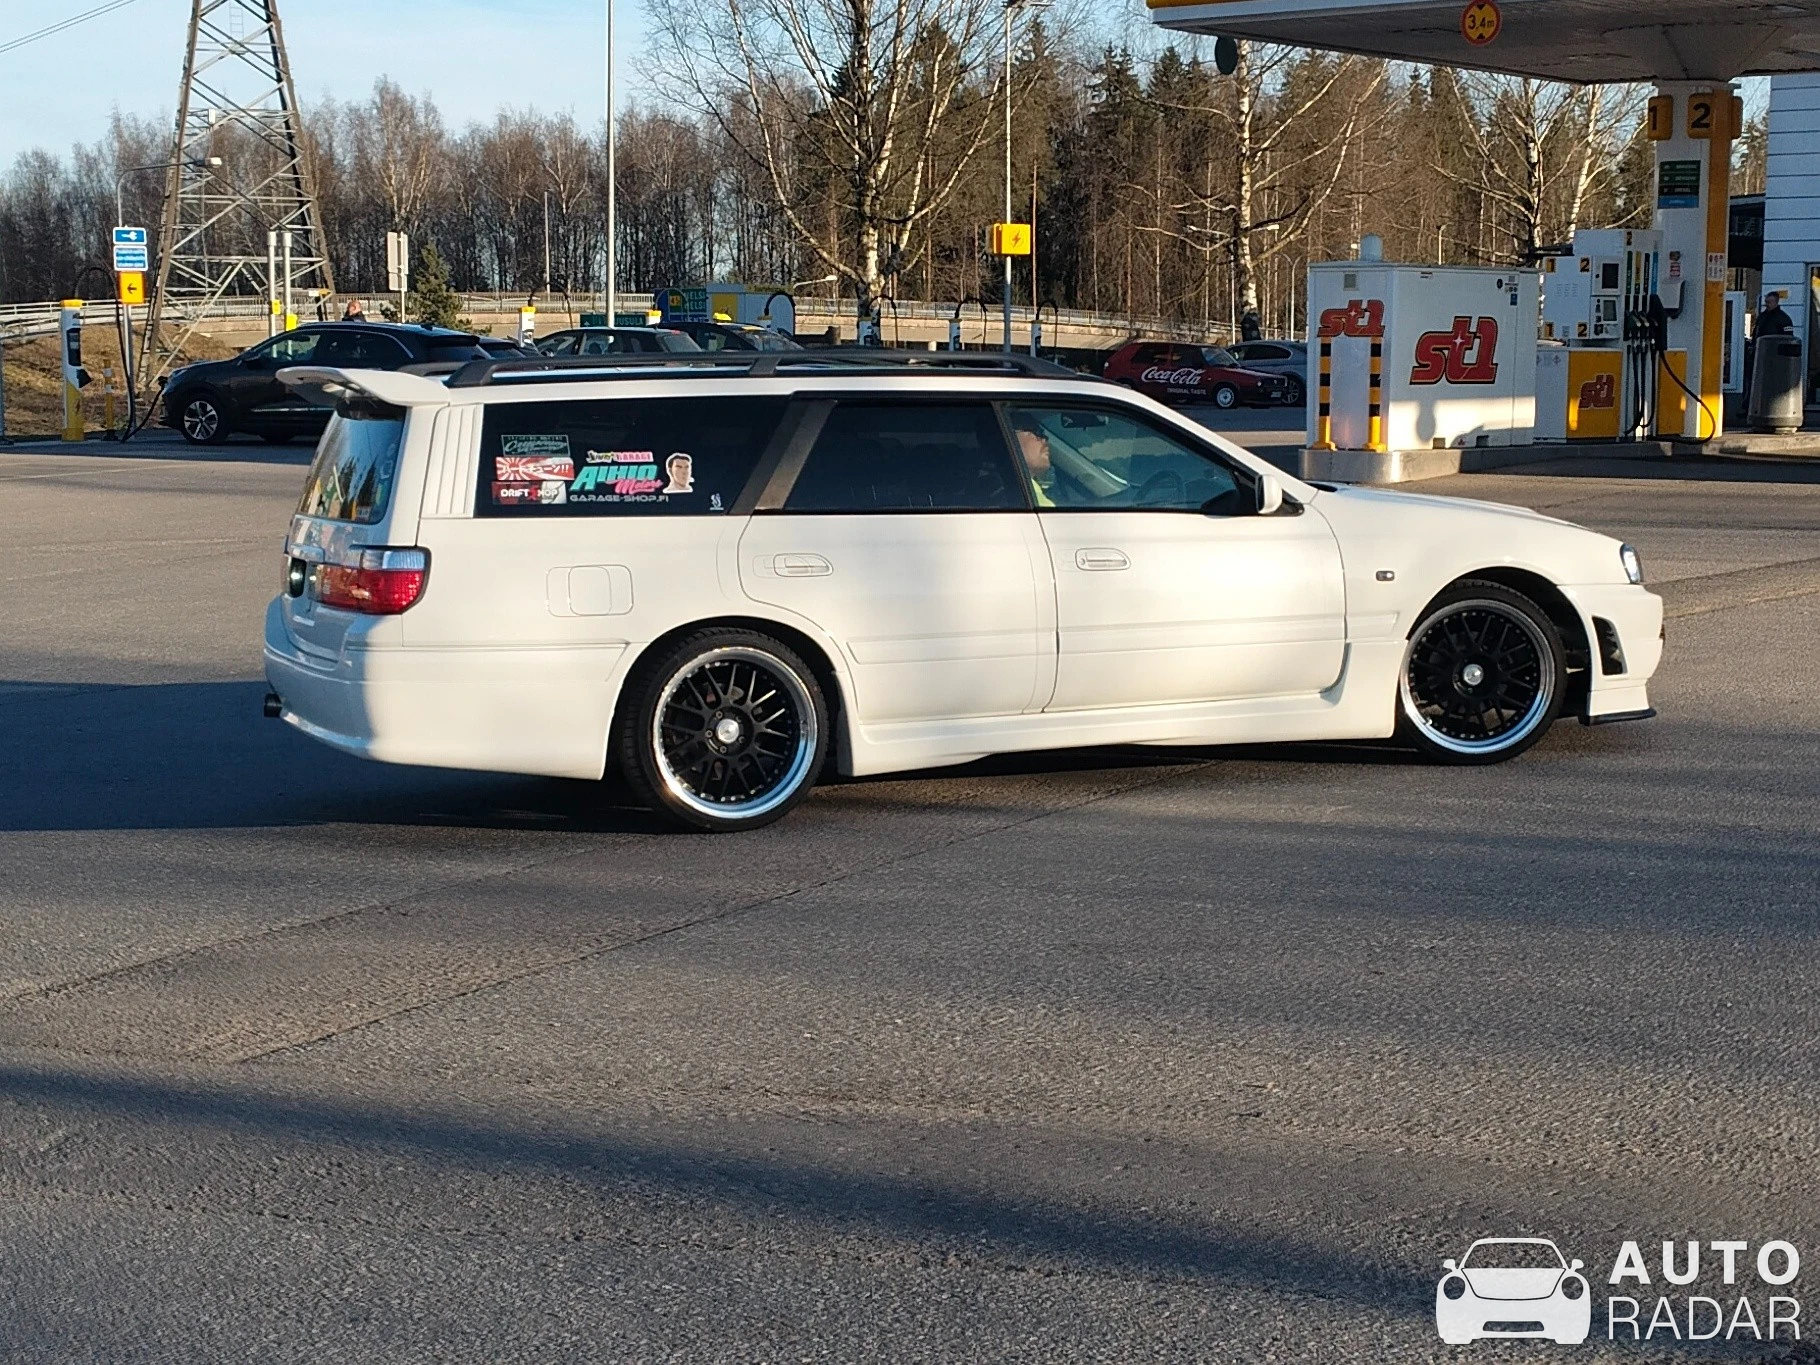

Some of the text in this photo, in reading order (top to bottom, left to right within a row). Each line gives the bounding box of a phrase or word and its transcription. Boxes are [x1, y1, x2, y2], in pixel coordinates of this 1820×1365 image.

[1648, 105, 1658, 131] 1
[1691, 102, 1711, 129] 2
[1578, 323, 1587, 337] 2
[1141, 366, 1207, 385] Coca-Cola
[500, 488, 529, 497] DRIFT
[569, 494, 669, 503] GARAGE-SHOP.FI
